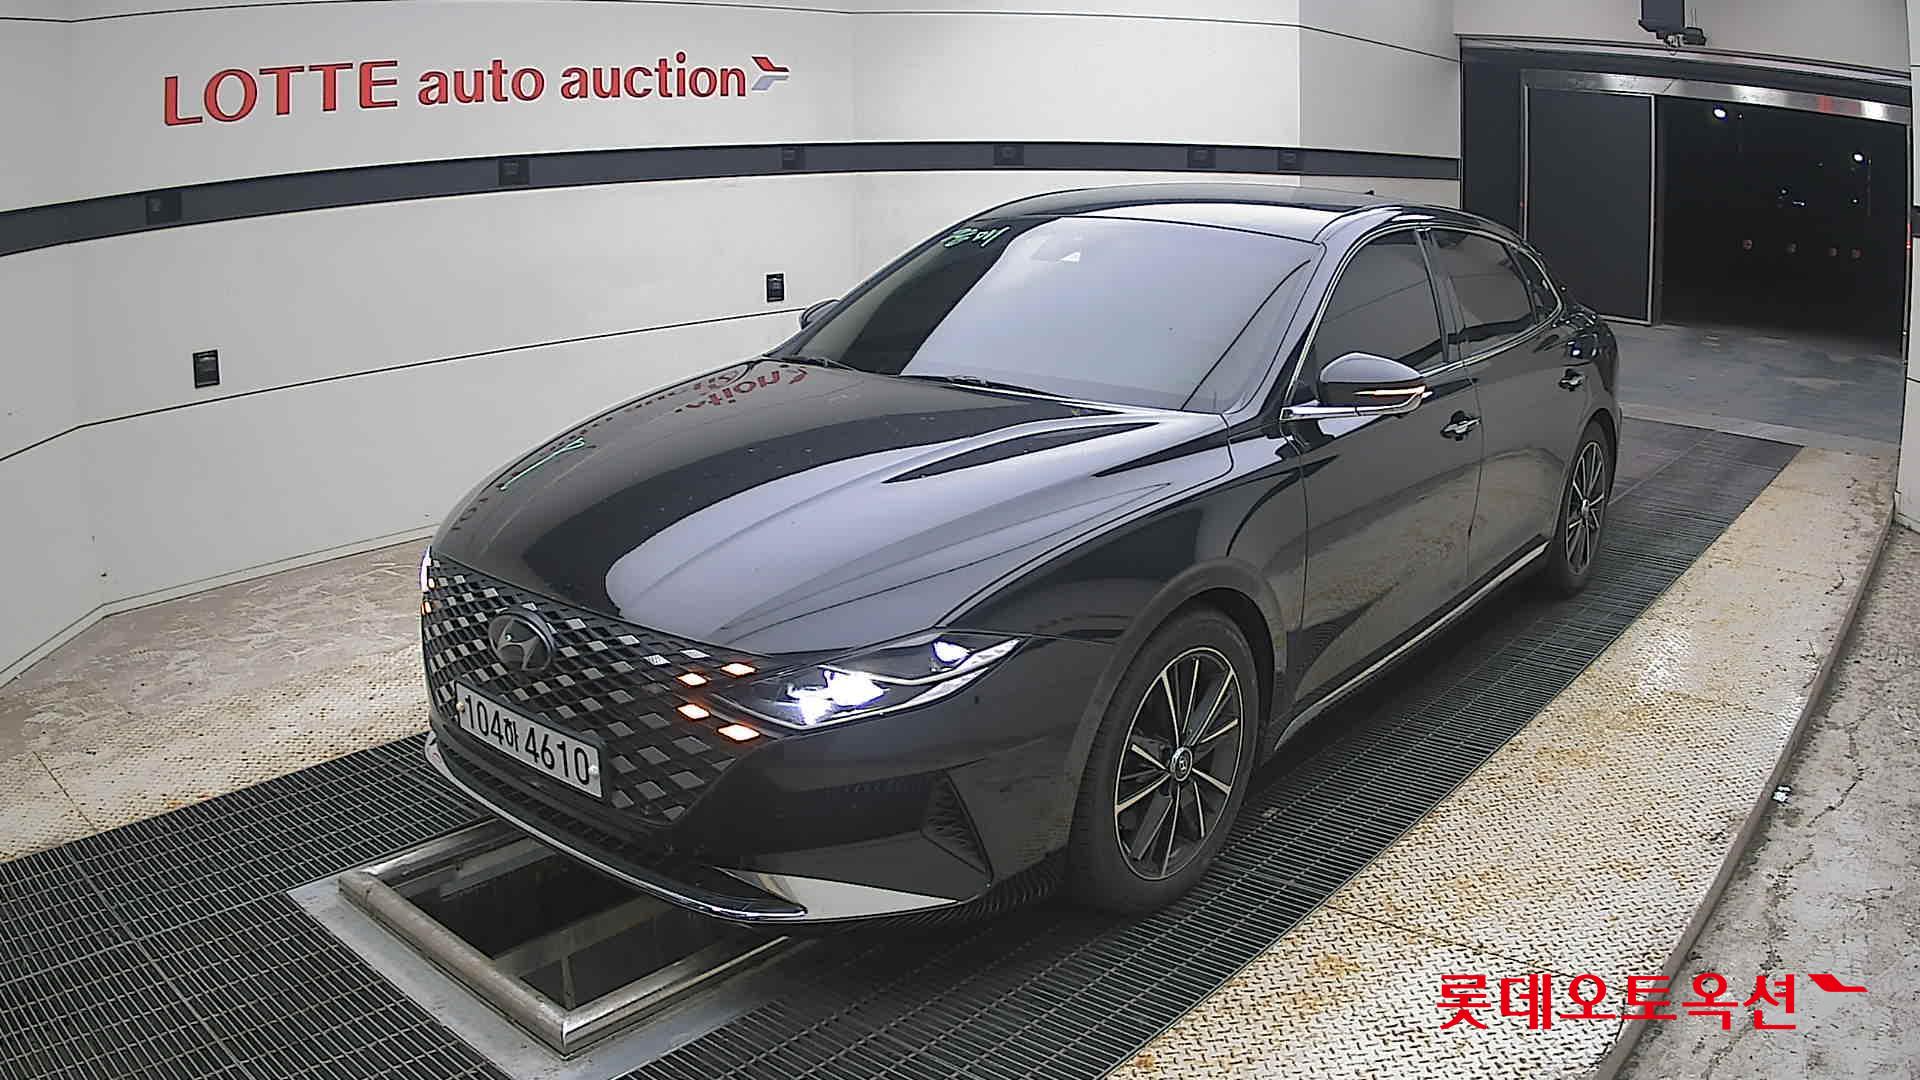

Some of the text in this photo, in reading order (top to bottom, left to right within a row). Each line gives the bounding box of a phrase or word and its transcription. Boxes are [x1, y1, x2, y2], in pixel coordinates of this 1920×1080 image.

[164, 50, 748, 126] LOTTE auto auction
[465, 694, 590, 785] 104하 4610
